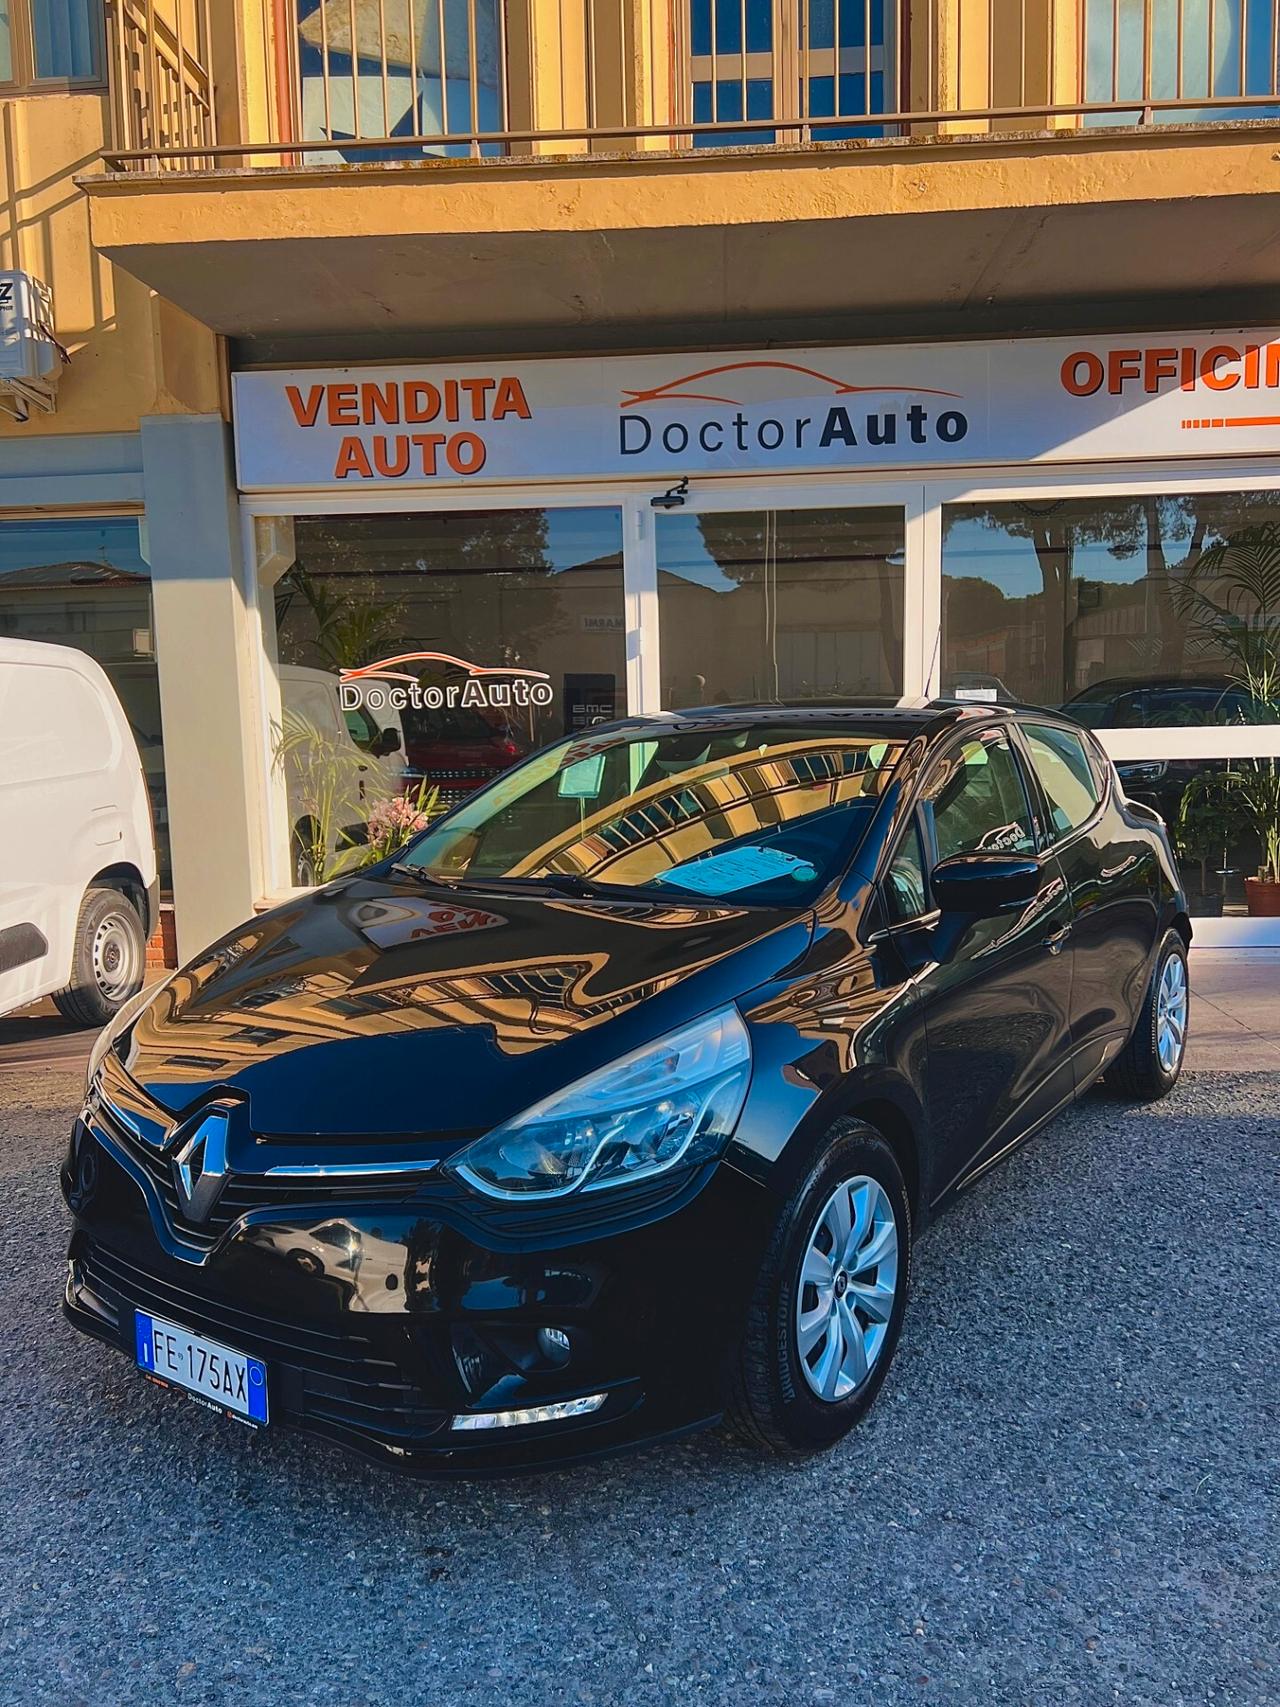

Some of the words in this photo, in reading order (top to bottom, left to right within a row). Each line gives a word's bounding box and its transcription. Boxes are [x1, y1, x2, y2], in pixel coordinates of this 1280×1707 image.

[285, 377, 532, 428] VENDITA
[334, 431, 487, 479] AUTO
[619, 404, 969, 456] DoctorAuto
[340, 679, 553, 712] DoctorAuto
[153, 1329, 179, 1372] FE
[185, 1343, 248, 1404] 175AX
